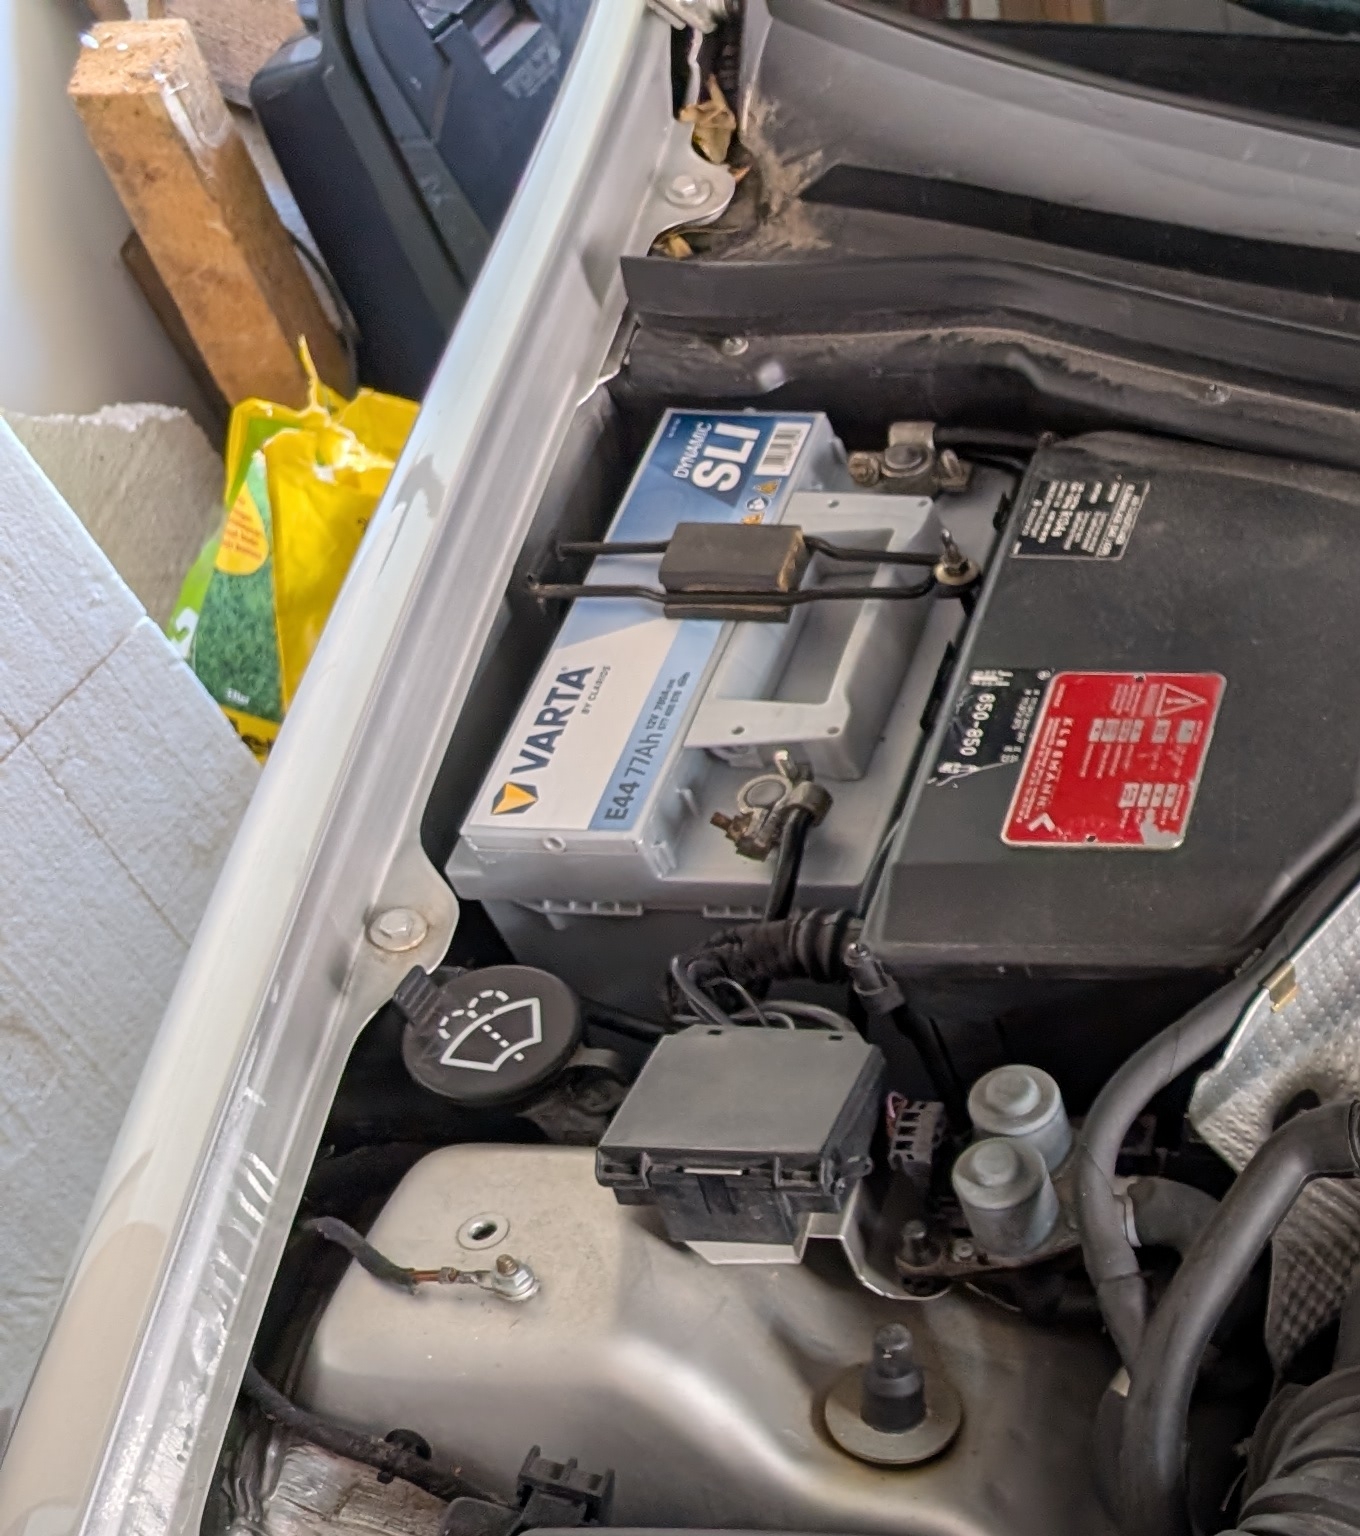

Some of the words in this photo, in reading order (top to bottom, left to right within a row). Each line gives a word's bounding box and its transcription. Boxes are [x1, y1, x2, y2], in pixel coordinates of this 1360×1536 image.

[673, 421, 712, 480] DYNAMIC
[691, 424, 762, 492] SLI
[511, 665, 595, 774] VARTA
[959, 692, 997, 757] 650-850
[604, 780, 640, 821] E44
[623, 732, 663, 778] 77Ah
